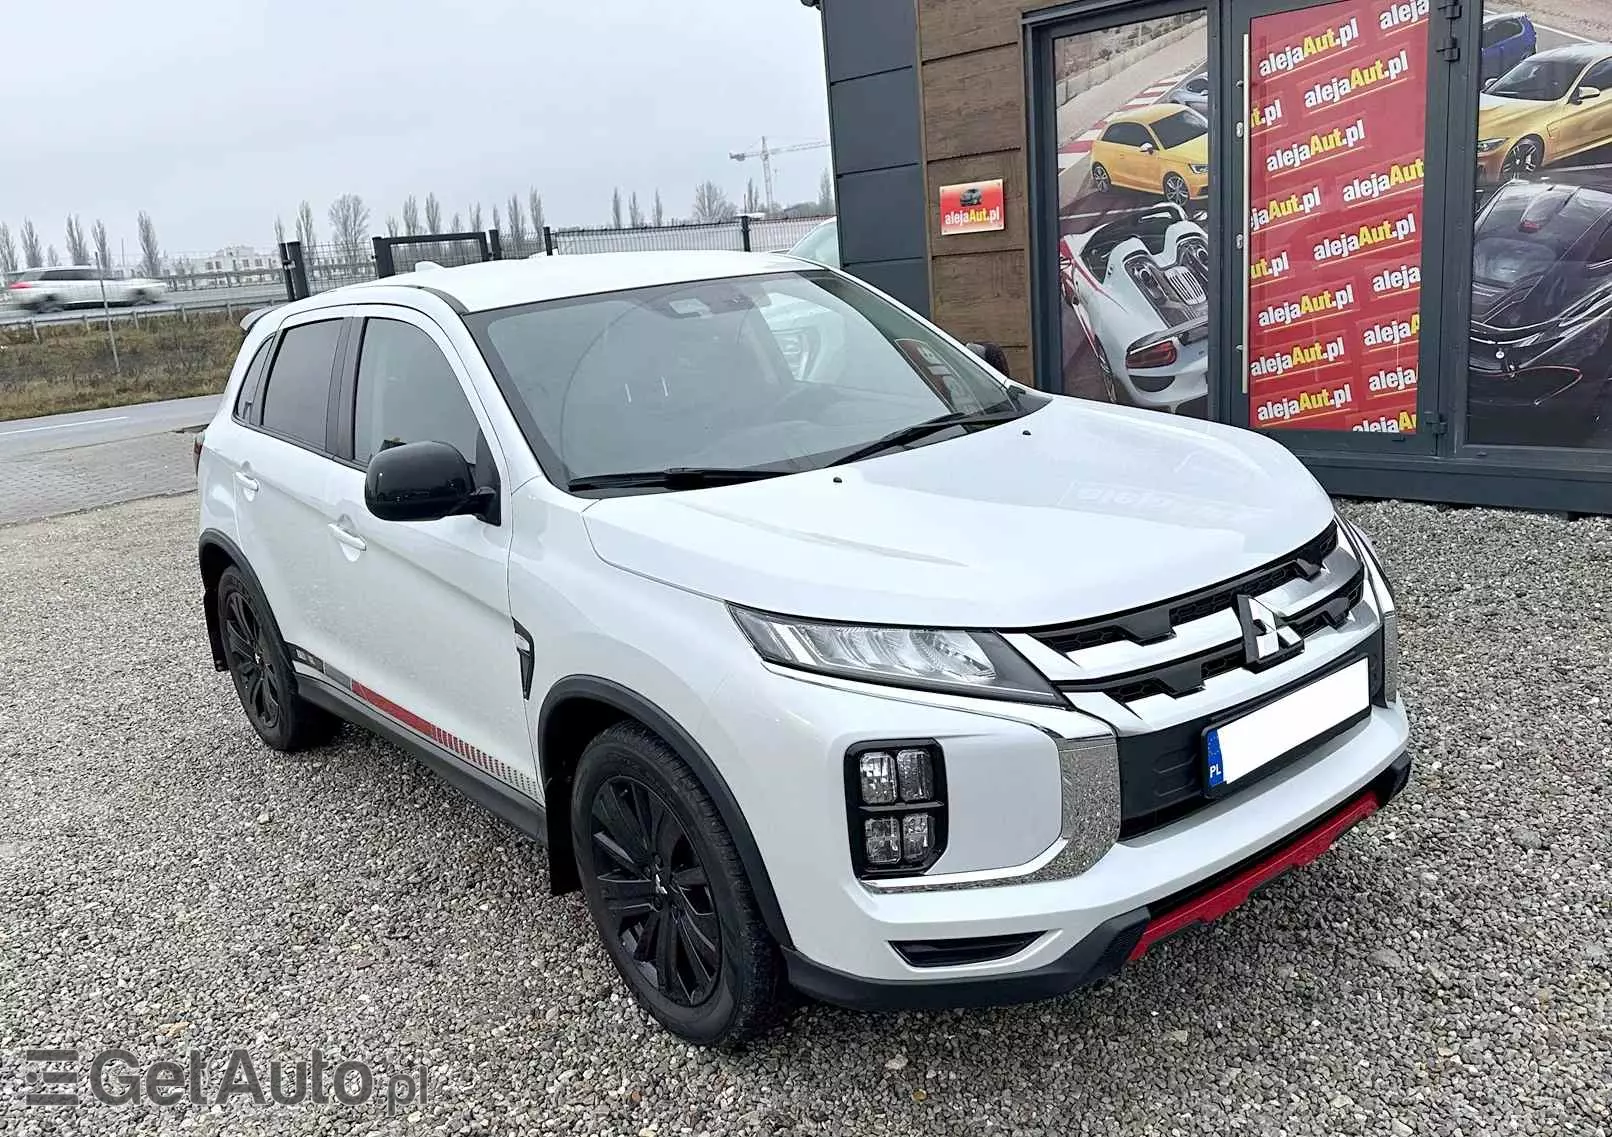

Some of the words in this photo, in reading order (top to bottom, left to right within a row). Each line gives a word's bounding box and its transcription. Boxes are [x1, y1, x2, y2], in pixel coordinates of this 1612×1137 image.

[1259, 18, 1359, 76] alejaAut.pl
[1304, 50, 1409, 108] alejaAut.pl
[1251, 99, 1282, 128] t.pl
[1267, 120, 1365, 172] alejaAut.pl
[1343, 158, 1424, 201] alejaAut
[945, 206, 1000, 226] alejaAut.pl
[1251, 186, 1320, 231] jaAut.pl
[1313, 213, 1417, 261] alejaAut.pl
[1372, 265, 1421, 292] aleja
[1258, 285, 1354, 327] alejaAut.pl
[1250, 337, 1345, 377] alejaAut.pl
[1369, 361, 1418, 391] aleja
[1257, 384, 1353, 420] alejaAut.pl
[1210, 763, 1222, 778] PL
